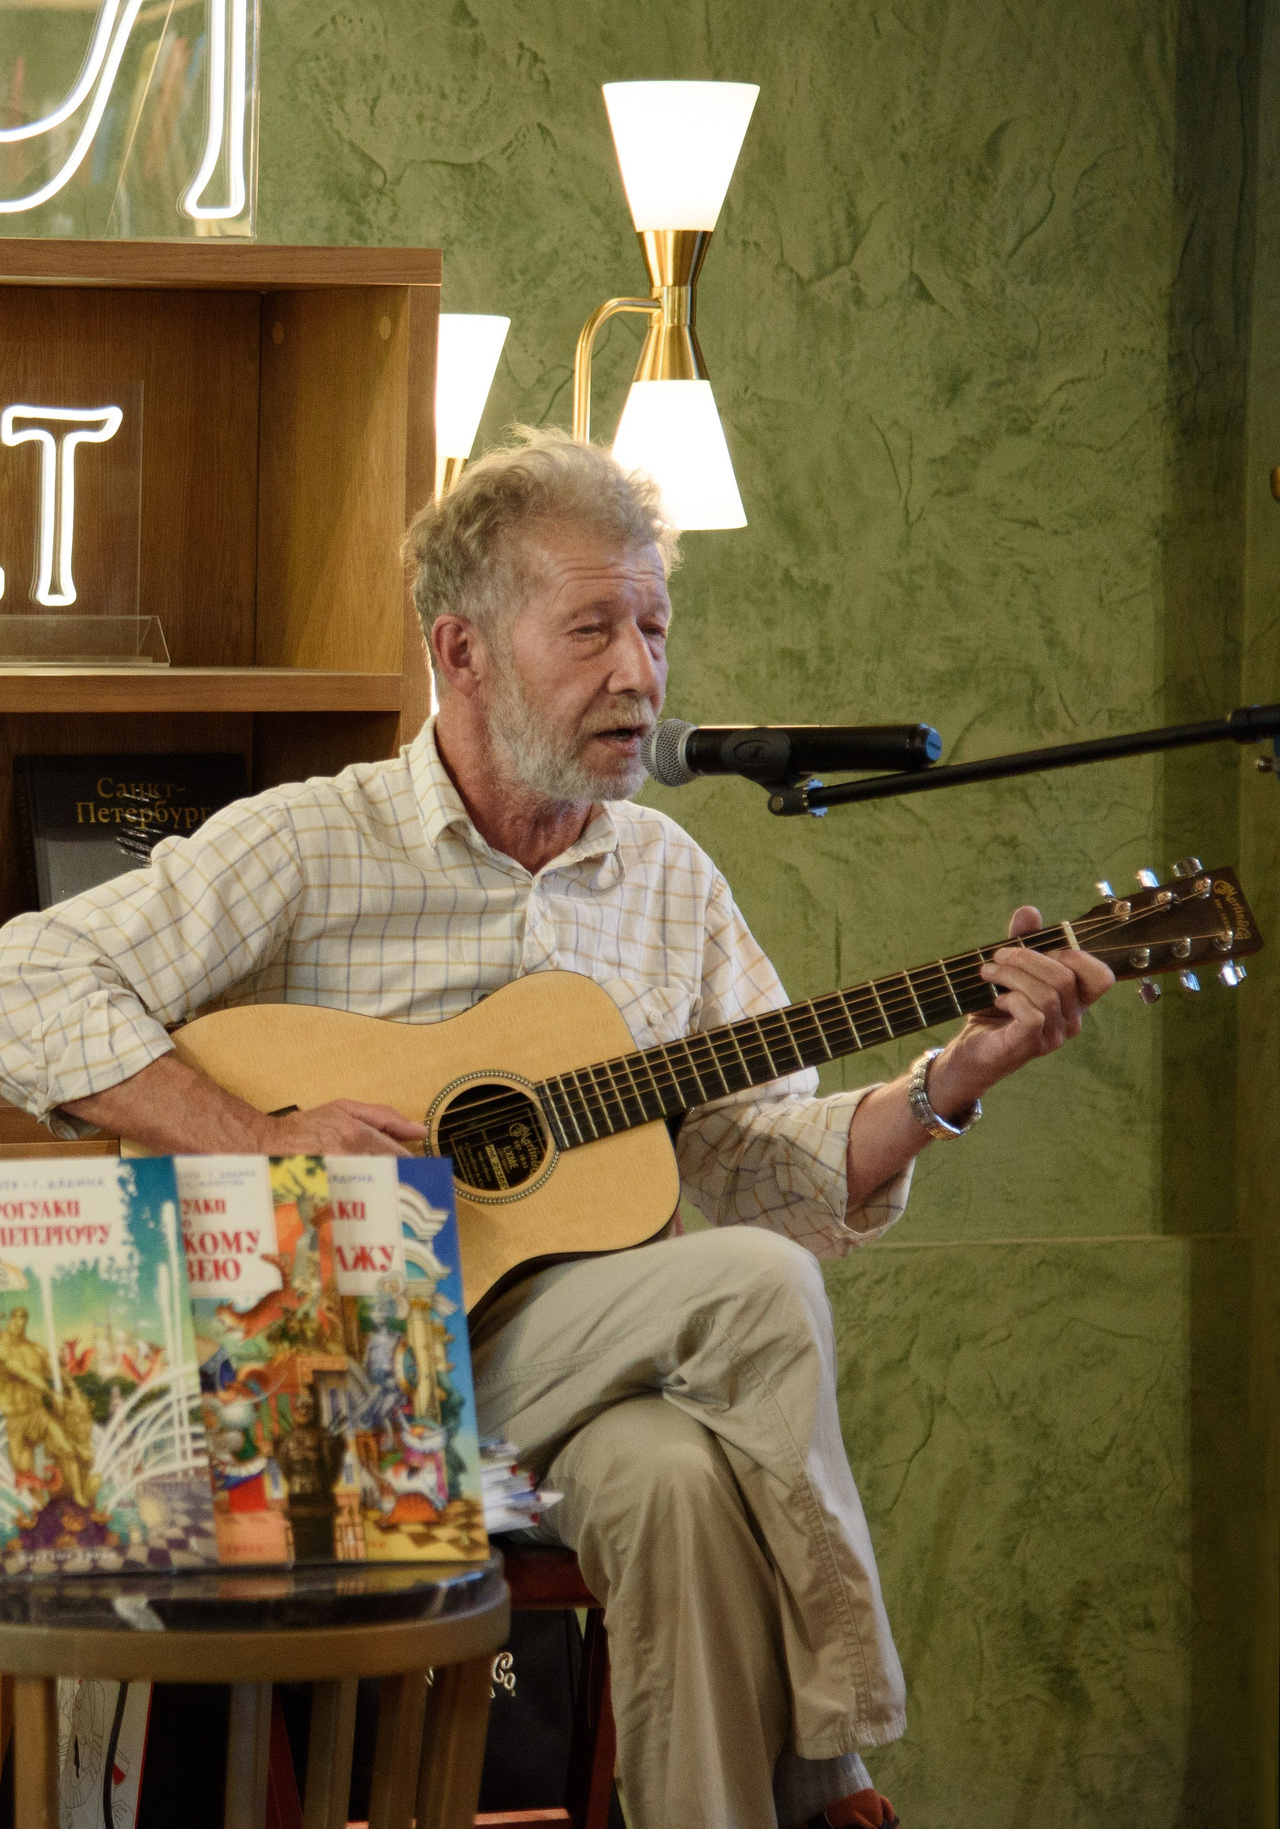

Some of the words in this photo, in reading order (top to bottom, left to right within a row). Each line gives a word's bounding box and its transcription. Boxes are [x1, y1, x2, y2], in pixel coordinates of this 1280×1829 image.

[96, 778, 186, 799] Санкт-
[75, 800, 212, 829] Петербург
[502, 1144, 519, 1170] LXME
[181, 1198, 226, 1216] УЛКИ
[182, 1229, 261, 1256] КОМУ
